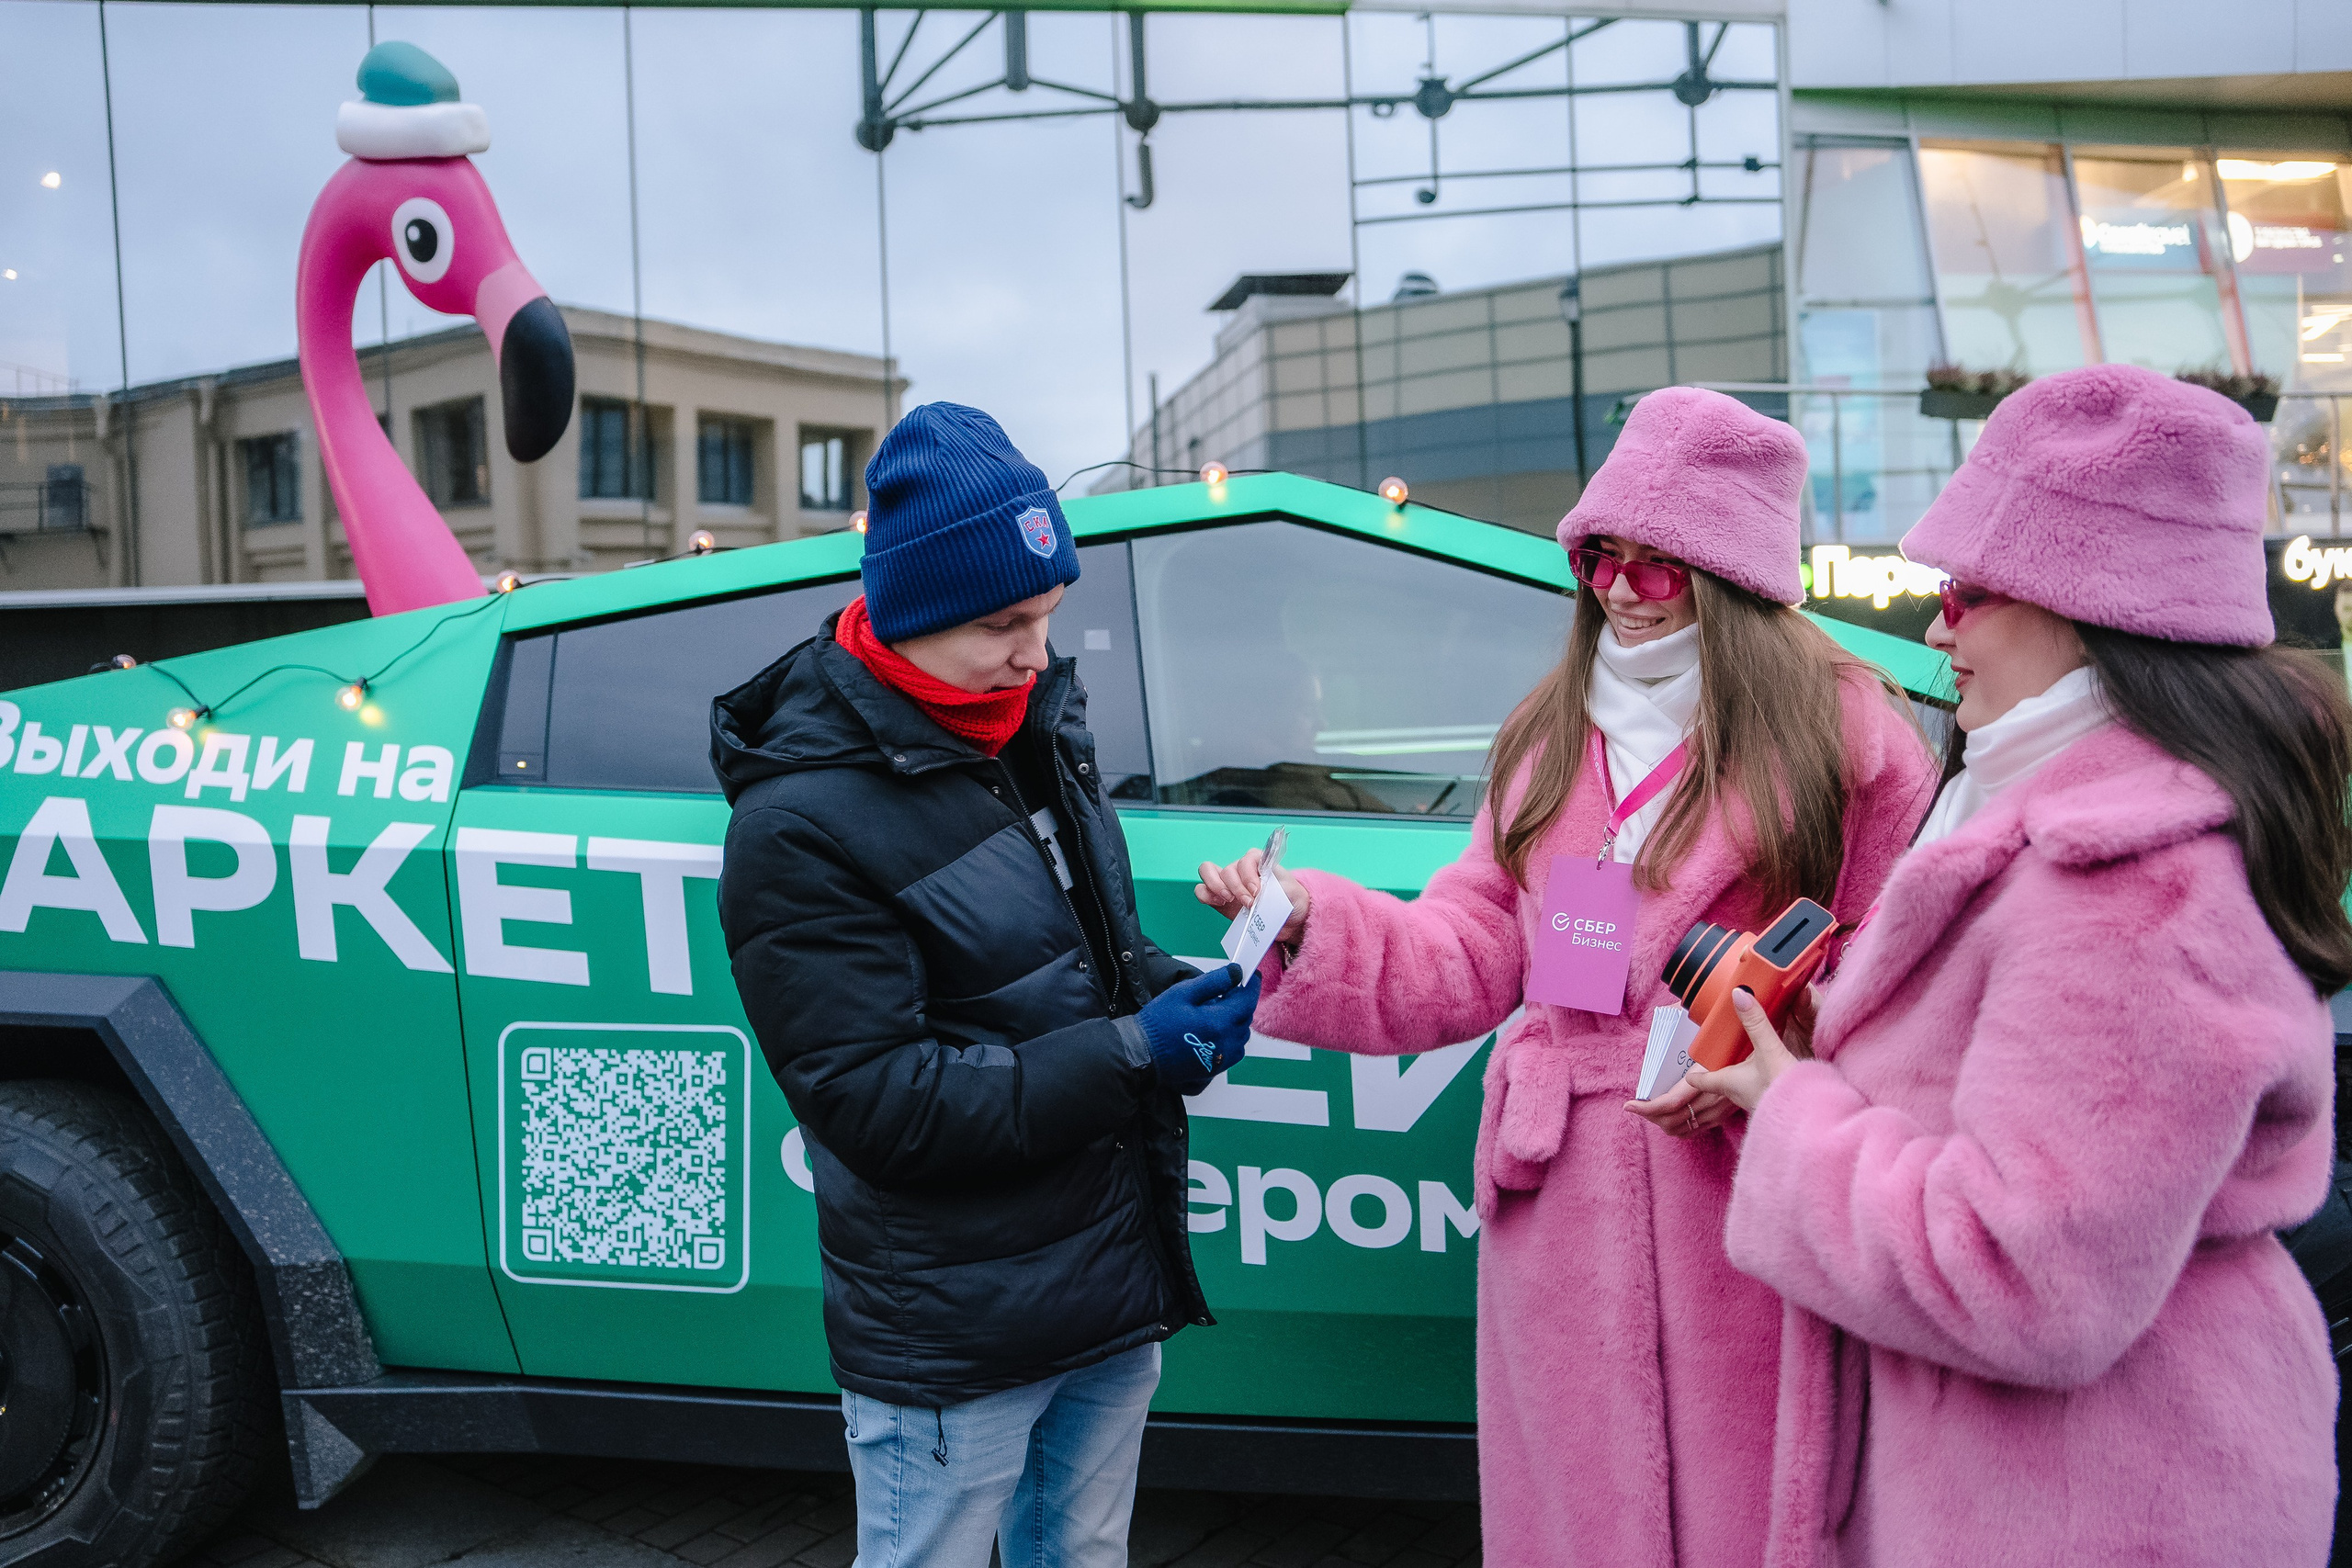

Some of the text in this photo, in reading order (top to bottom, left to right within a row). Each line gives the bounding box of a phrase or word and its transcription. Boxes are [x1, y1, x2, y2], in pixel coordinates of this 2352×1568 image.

[1024, 516, 1048, 532] СКА
[1813, 545, 1951, 611] Пере
[337, 740, 454, 804] на
[1253, 914, 1265, 931] СБЕР
[1574, 919, 1616, 935] СБЕР
[1571, 932, 1623, 952] Бизнес
